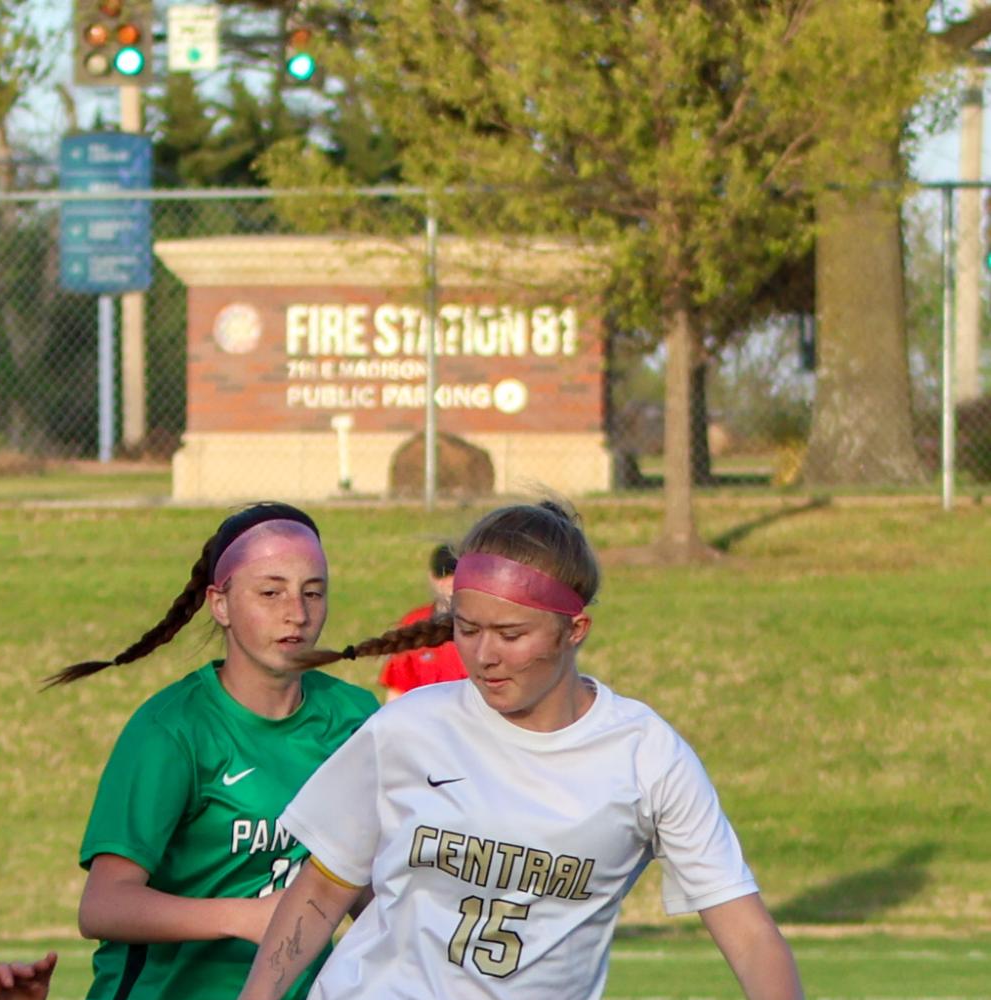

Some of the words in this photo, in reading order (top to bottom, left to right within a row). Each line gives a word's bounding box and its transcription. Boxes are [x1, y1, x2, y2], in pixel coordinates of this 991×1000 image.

[286, 305, 369, 355] FIRE
[373, 305, 528, 356] STATION
[532, 306, 577, 356] 81
[320, 360, 334, 379] E
[337, 360, 428, 380] MADISON
[287, 384, 375, 408] PUBLIC
[381, 384, 493, 408] PARKING
[231, 818, 299, 855] PAN
[409, 824, 596, 901] CENTRAL
[447, 894, 531, 979] 15
